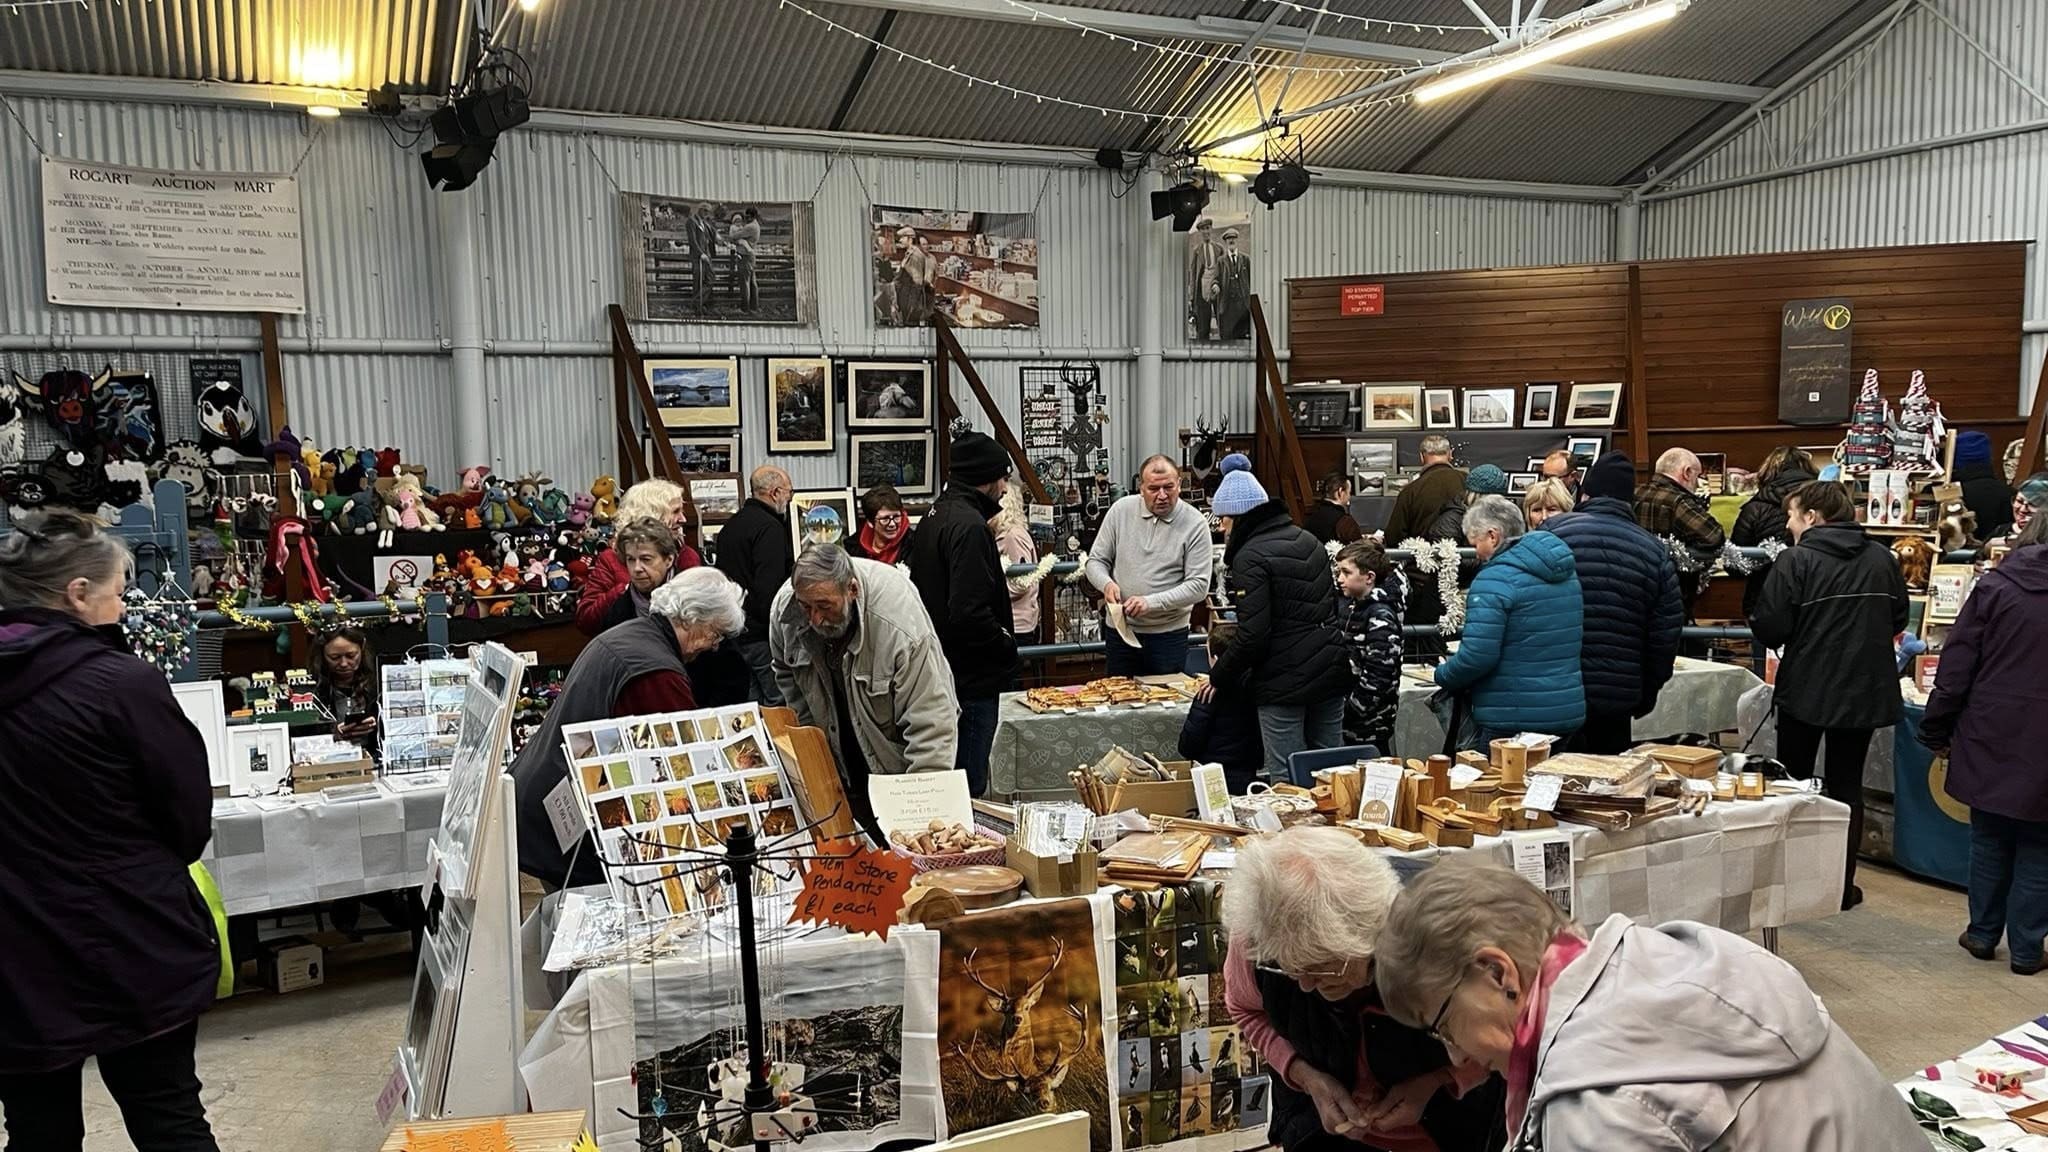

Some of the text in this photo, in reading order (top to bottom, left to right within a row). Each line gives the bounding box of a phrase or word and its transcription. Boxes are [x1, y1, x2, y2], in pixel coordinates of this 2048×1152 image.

[69, 168, 276, 193] ROGART AUCTION MART
[48, 200, 85, 208] SPECIAL
[89, 201, 112, 209] SALE
[126, 204, 140, 212] Hill
[153, 200, 204, 209] SEPTEMBER
[262, 205, 297, 214] ANNUAL
[131, 224, 183, 233] SEPTEMBER
[197, 227, 233, 235] ANNUAL
[238, 229, 273, 238] SPECIAL
[277, 231, 298, 239] SALE
[188, 245, 217, 253] accepted
[221, 245, 230, 253] for
[197, 267, 234, 275] ANNUAL
[132, 286, 173, 294] respectfully
[855, 860, 898, 882] Stone
[812, 873, 886, 897] Pendants
[804, 894, 877, 917] £1 each
